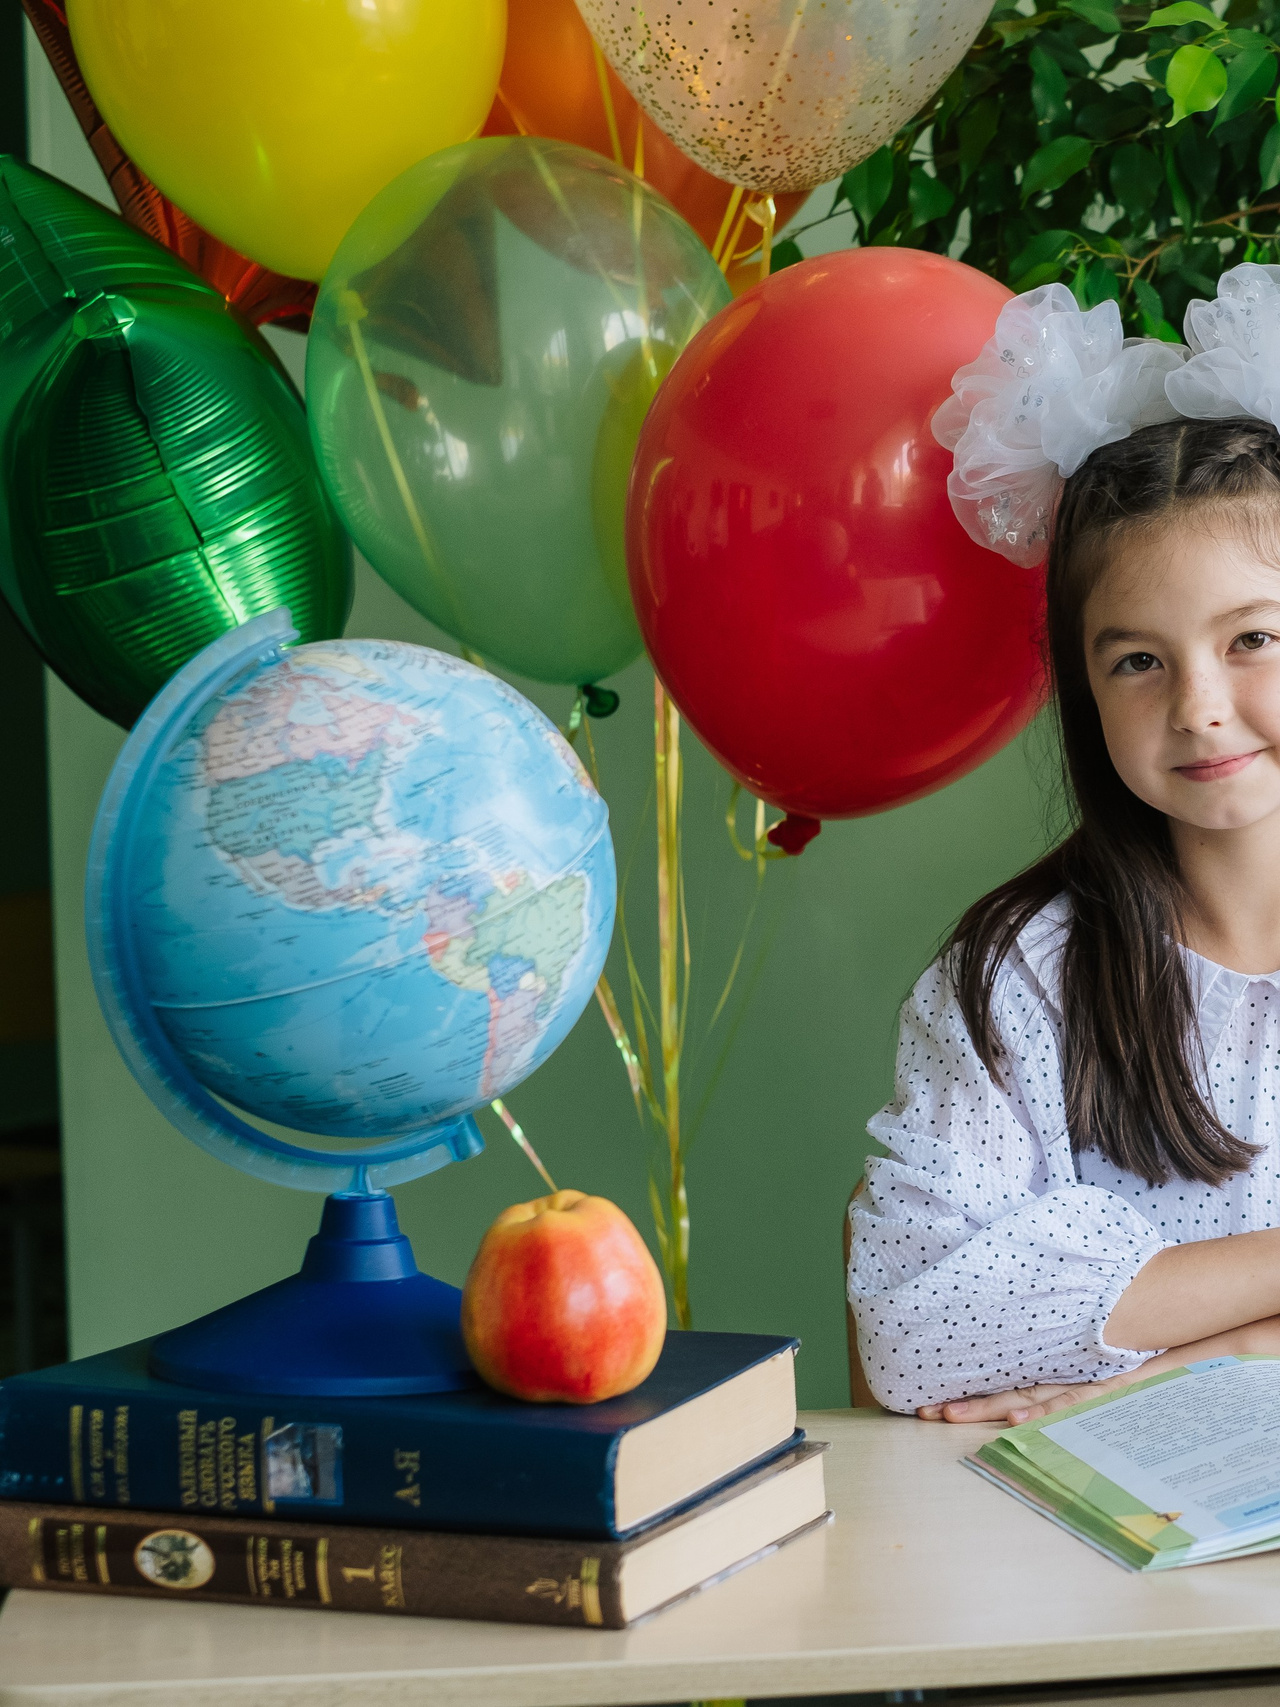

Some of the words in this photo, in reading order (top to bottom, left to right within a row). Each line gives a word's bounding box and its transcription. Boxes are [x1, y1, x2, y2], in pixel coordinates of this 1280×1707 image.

[198, 1420, 218, 1507] СЛОВАРЬ
[217, 1416, 238, 1510] РУССКОГО
[237, 1432, 257, 1502] ЯЗЫКА
[341, 1565, 376, 1583] 1
